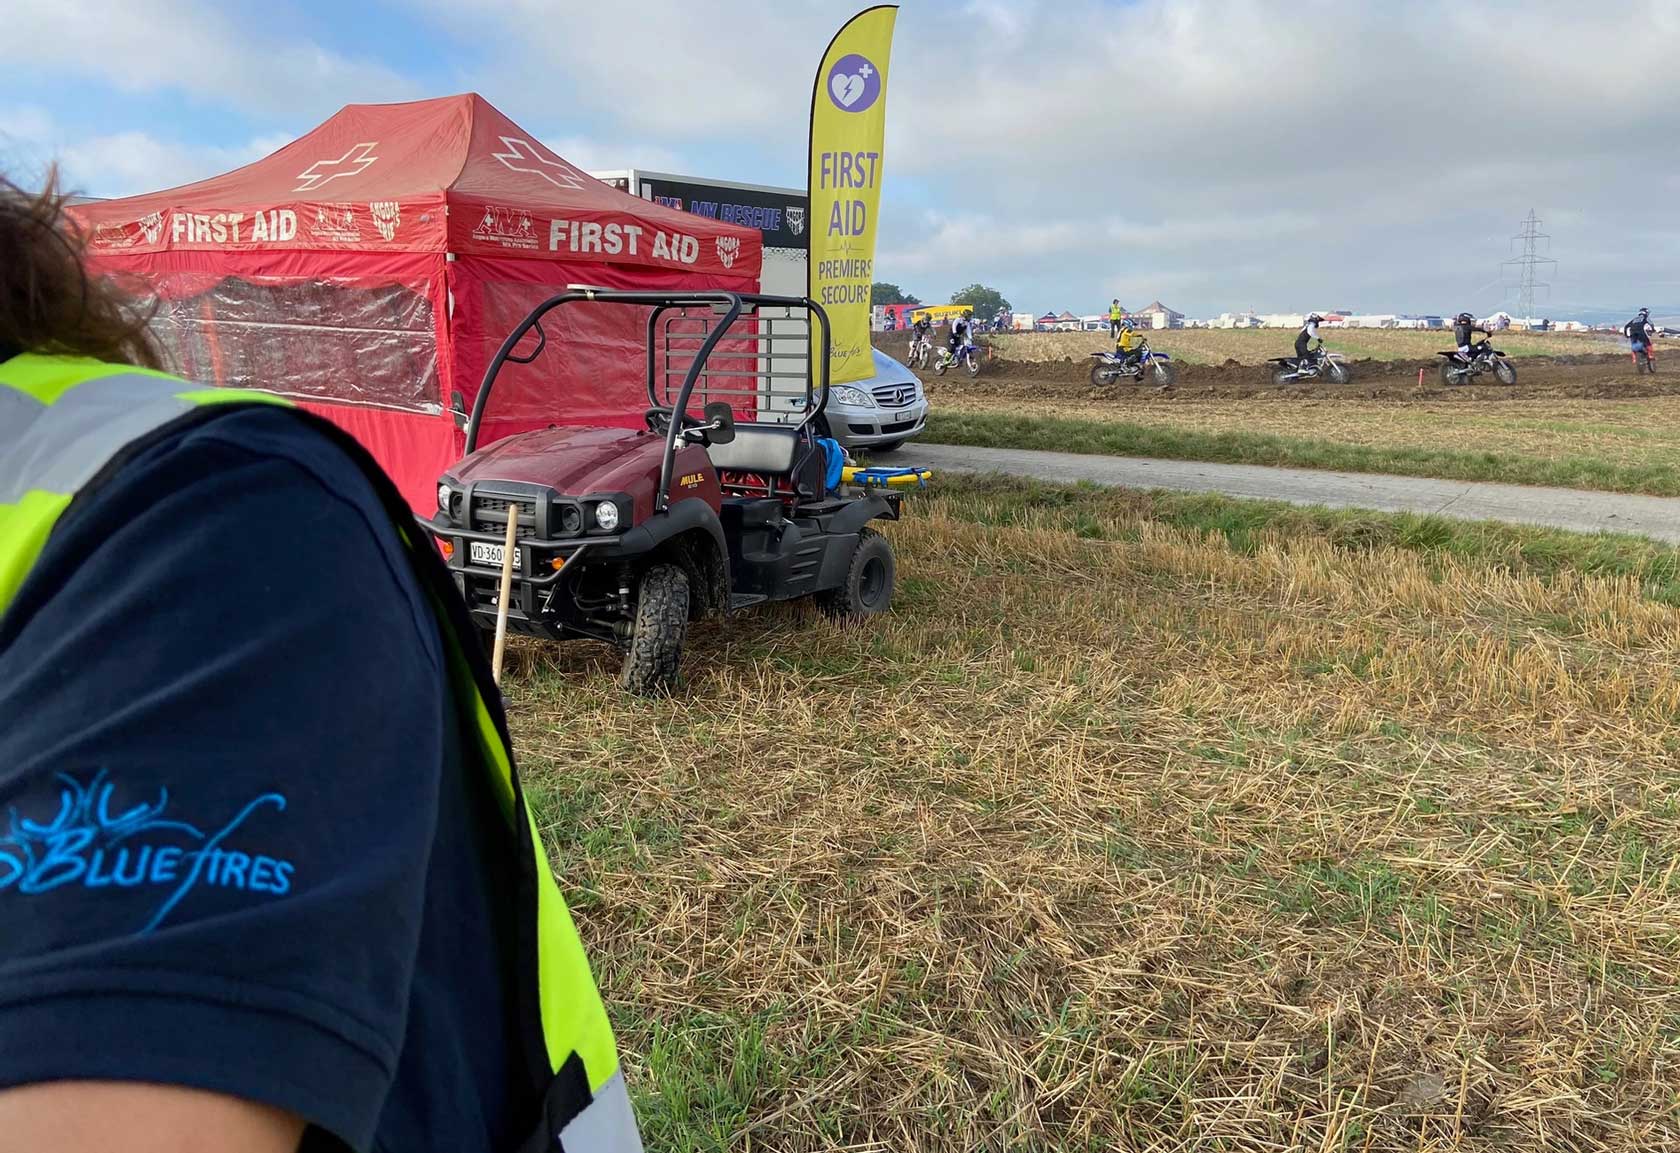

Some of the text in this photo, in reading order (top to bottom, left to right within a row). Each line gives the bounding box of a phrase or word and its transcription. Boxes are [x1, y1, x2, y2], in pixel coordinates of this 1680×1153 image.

[820, 151, 879, 190] FIRST
[172, 211, 244, 244] FIRST
[250, 209, 298, 243] AID
[721, 203, 783, 231] RESCUE
[828, 200, 867, 237] AID
[549, 218, 700, 265] FIRST AID
[819, 259, 872, 281] PREMIERS
[821, 284, 870, 306] SECOURS
[680, 473, 705, 487] MULE
